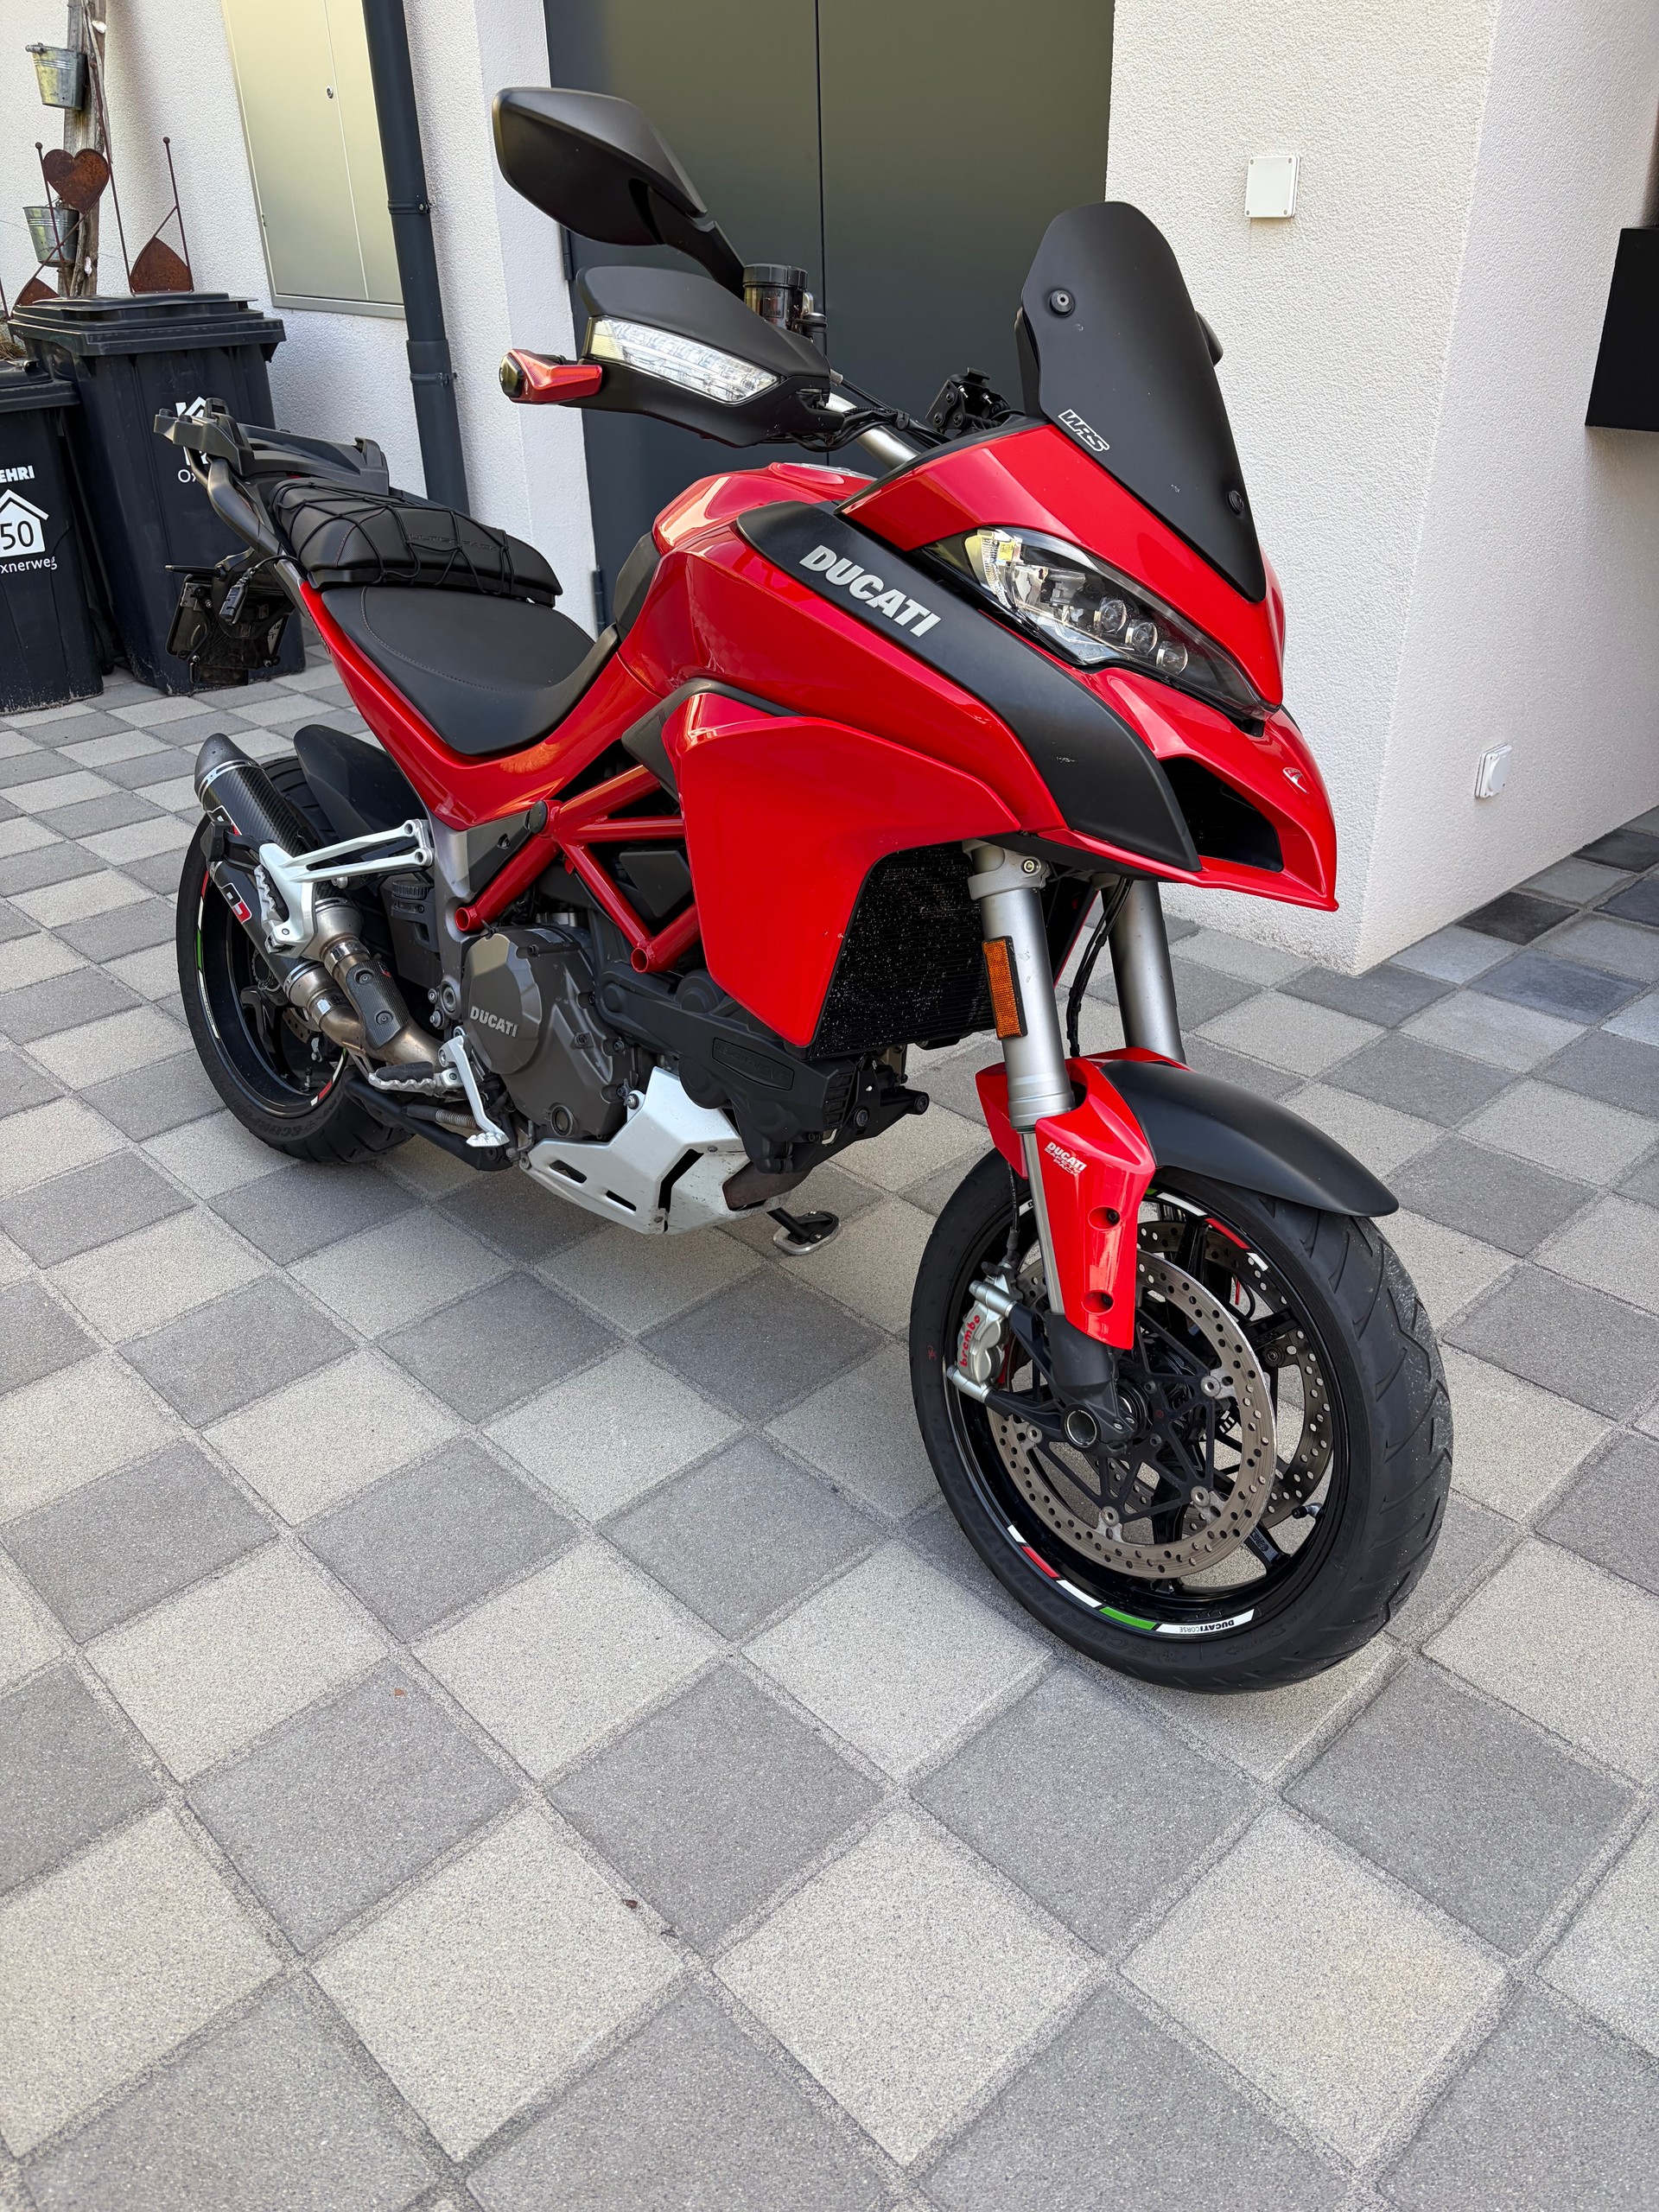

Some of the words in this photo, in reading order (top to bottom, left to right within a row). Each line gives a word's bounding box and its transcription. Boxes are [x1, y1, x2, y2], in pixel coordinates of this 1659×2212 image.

[1058, 409, 1110, 452] WRS
[0, 520, 35, 550] 50
[798, 544, 942, 638] DUCATI
[469, 1005, 518, 1038] DUCATI
[1046, 1141, 1087, 1172] DUCATI
[959, 1314, 981, 1367] brembo
